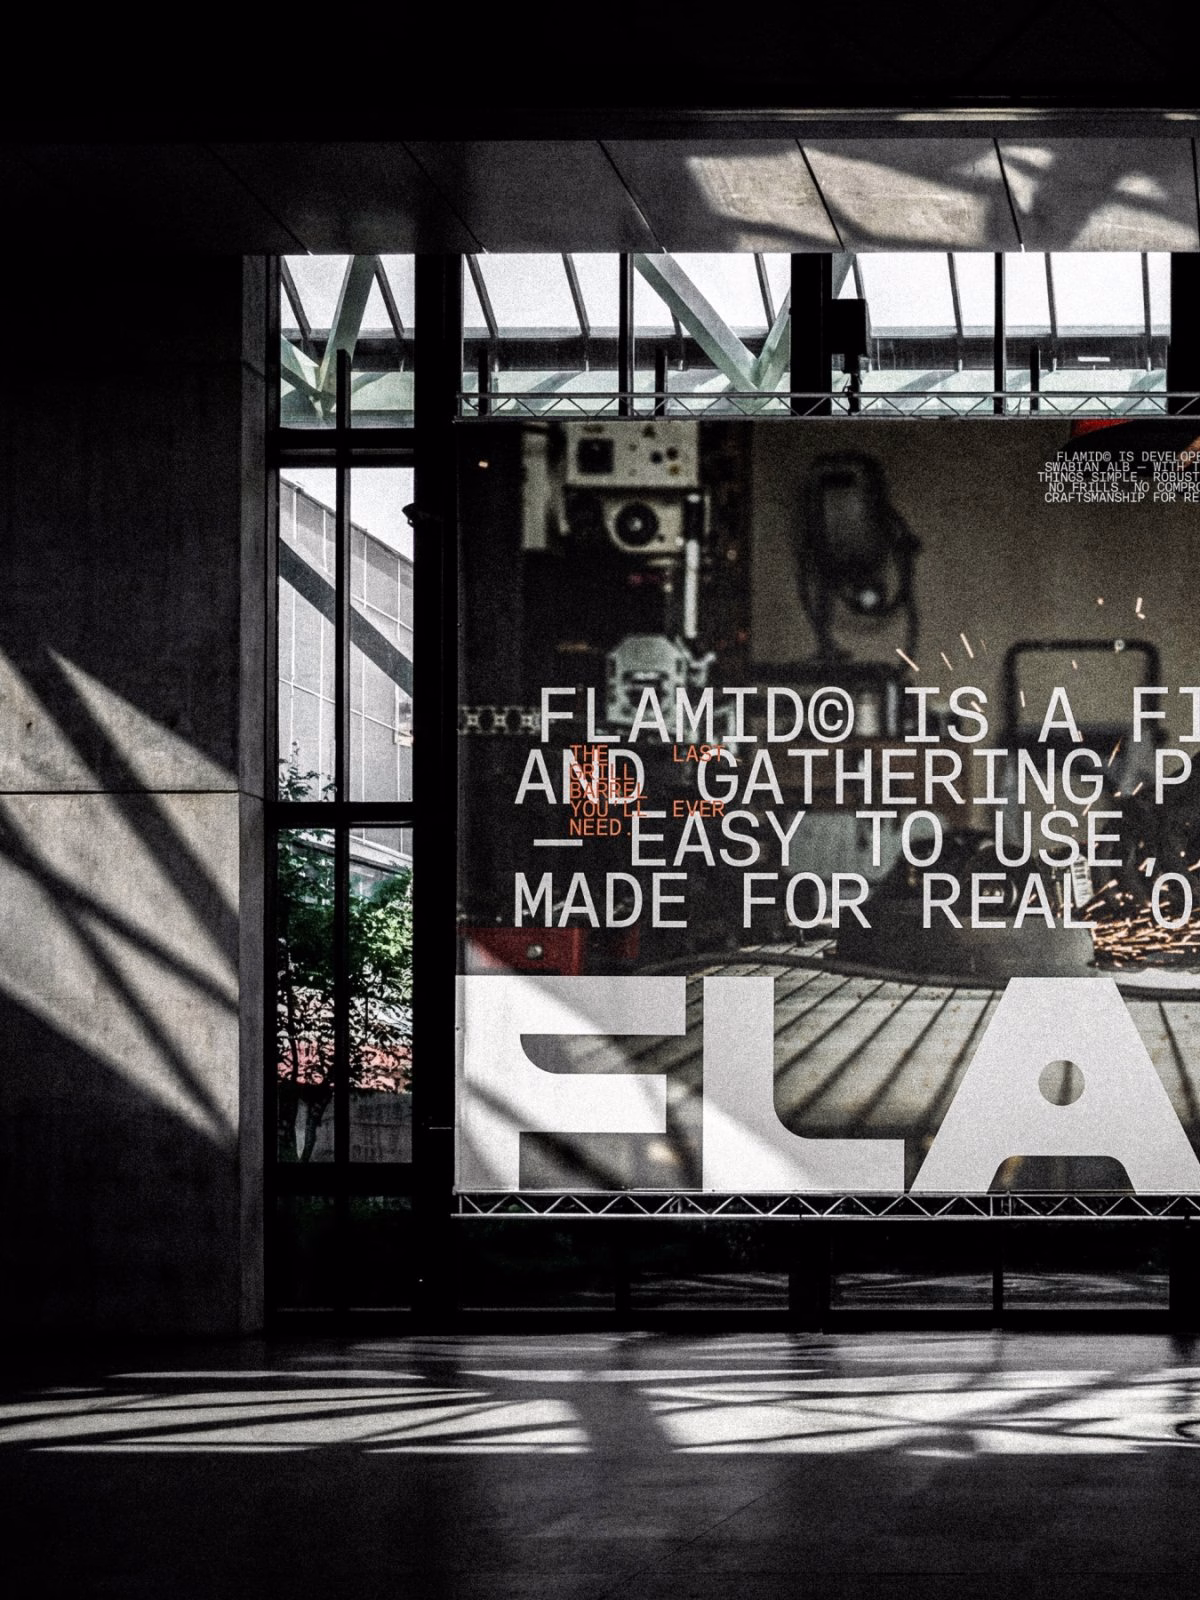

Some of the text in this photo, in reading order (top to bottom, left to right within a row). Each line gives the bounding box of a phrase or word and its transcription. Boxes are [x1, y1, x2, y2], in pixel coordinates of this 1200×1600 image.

[1057, 451, 1111, 461] FLAMID©
[1119, 451, 1134, 461] IS
[1045, 462, 1099, 472] SWABIAN
[1107, 462, 1130, 472] ALB
[1154, 462, 1184, 472] WITH
[1037, 472, 1084, 482] THINGS
[1092, 472, 1143, 484] SIMPLE,
[1049, 482, 1064, 492] NO
[1073, 482, 1124, 492] FRILLS.
[1135, 482, 1150, 492] NO
[1045, 492, 1145, 502] CRAFTSMANSHIP
[1154, 492, 1176, 502] FOR
[541, 686, 855, 743] FLAMID©
[905, 686, 988, 743] IS
[1038, 686, 1087, 743] A
[570, 745, 725, 762] THE LAST
[515, 749, 645, 805] AND
[698, 748, 1103, 805] GATHERING
[570, 763, 635, 780] GRILL
[570, 782, 648, 799] BARREL
[570, 800, 724, 817] YOU'LL EVER
[570, 819, 631, 835] NEED.
[631, 811, 805, 866] EASY
[856, 811, 943, 866] TO
[996, 811, 1157, 877] USE,
[515, 873, 687, 928] MADE
[744, 873, 872, 928] FOR
[923, 873, 1098, 928] REAL
